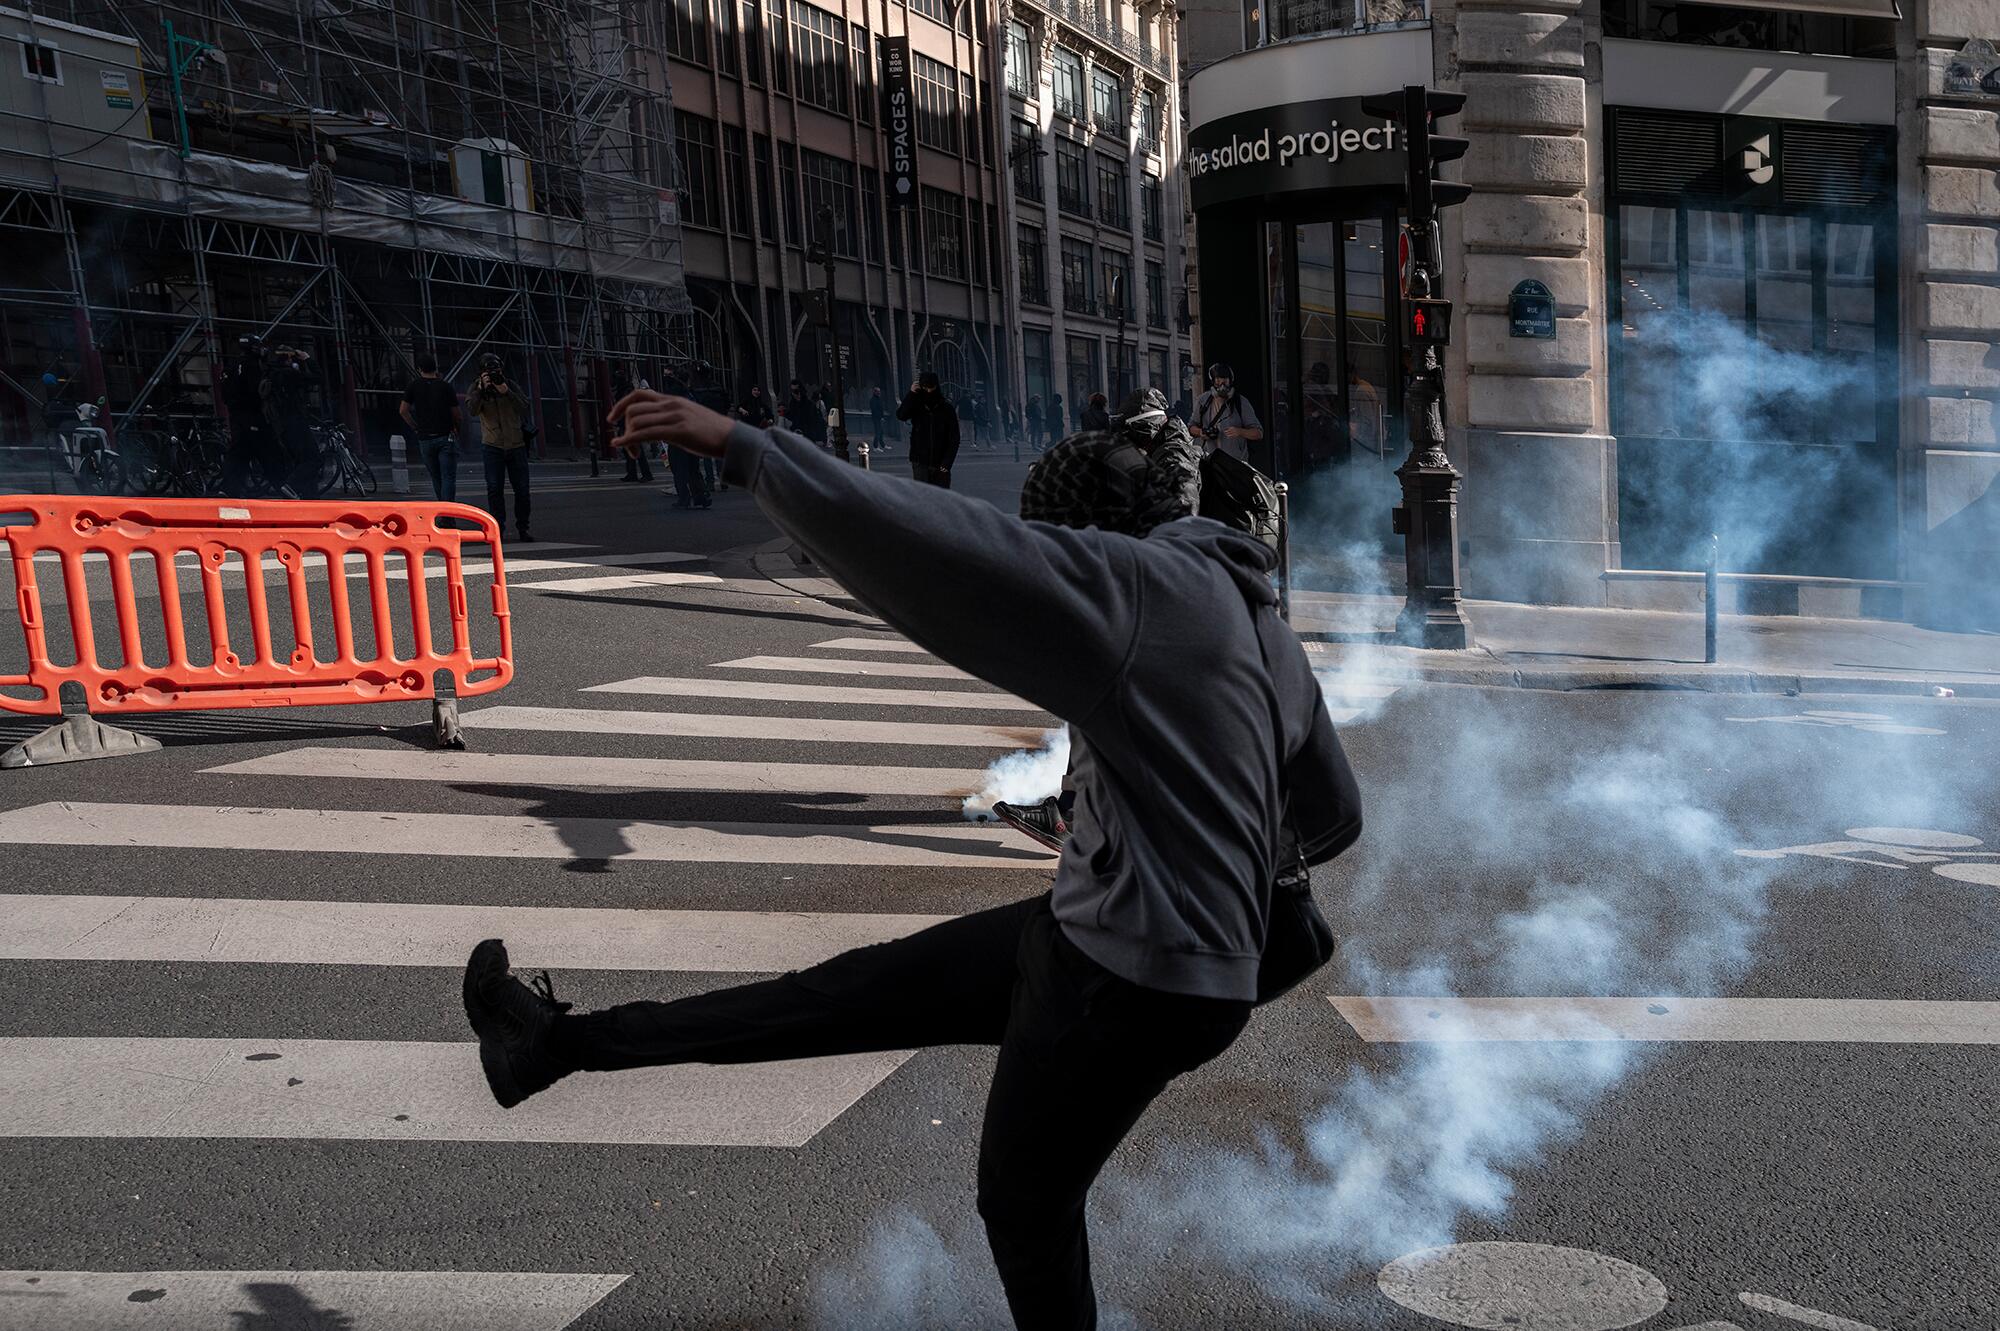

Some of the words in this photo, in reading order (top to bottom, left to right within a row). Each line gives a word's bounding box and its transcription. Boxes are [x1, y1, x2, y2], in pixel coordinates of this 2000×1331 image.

[1189, 147, 1208, 178] the
[1211, 128, 1270, 170] salad
[1277, 119, 1396, 166] project
[1526, 306, 1539, 314] RUE
[1515, 319, 1551, 328] MONTMARTRE
